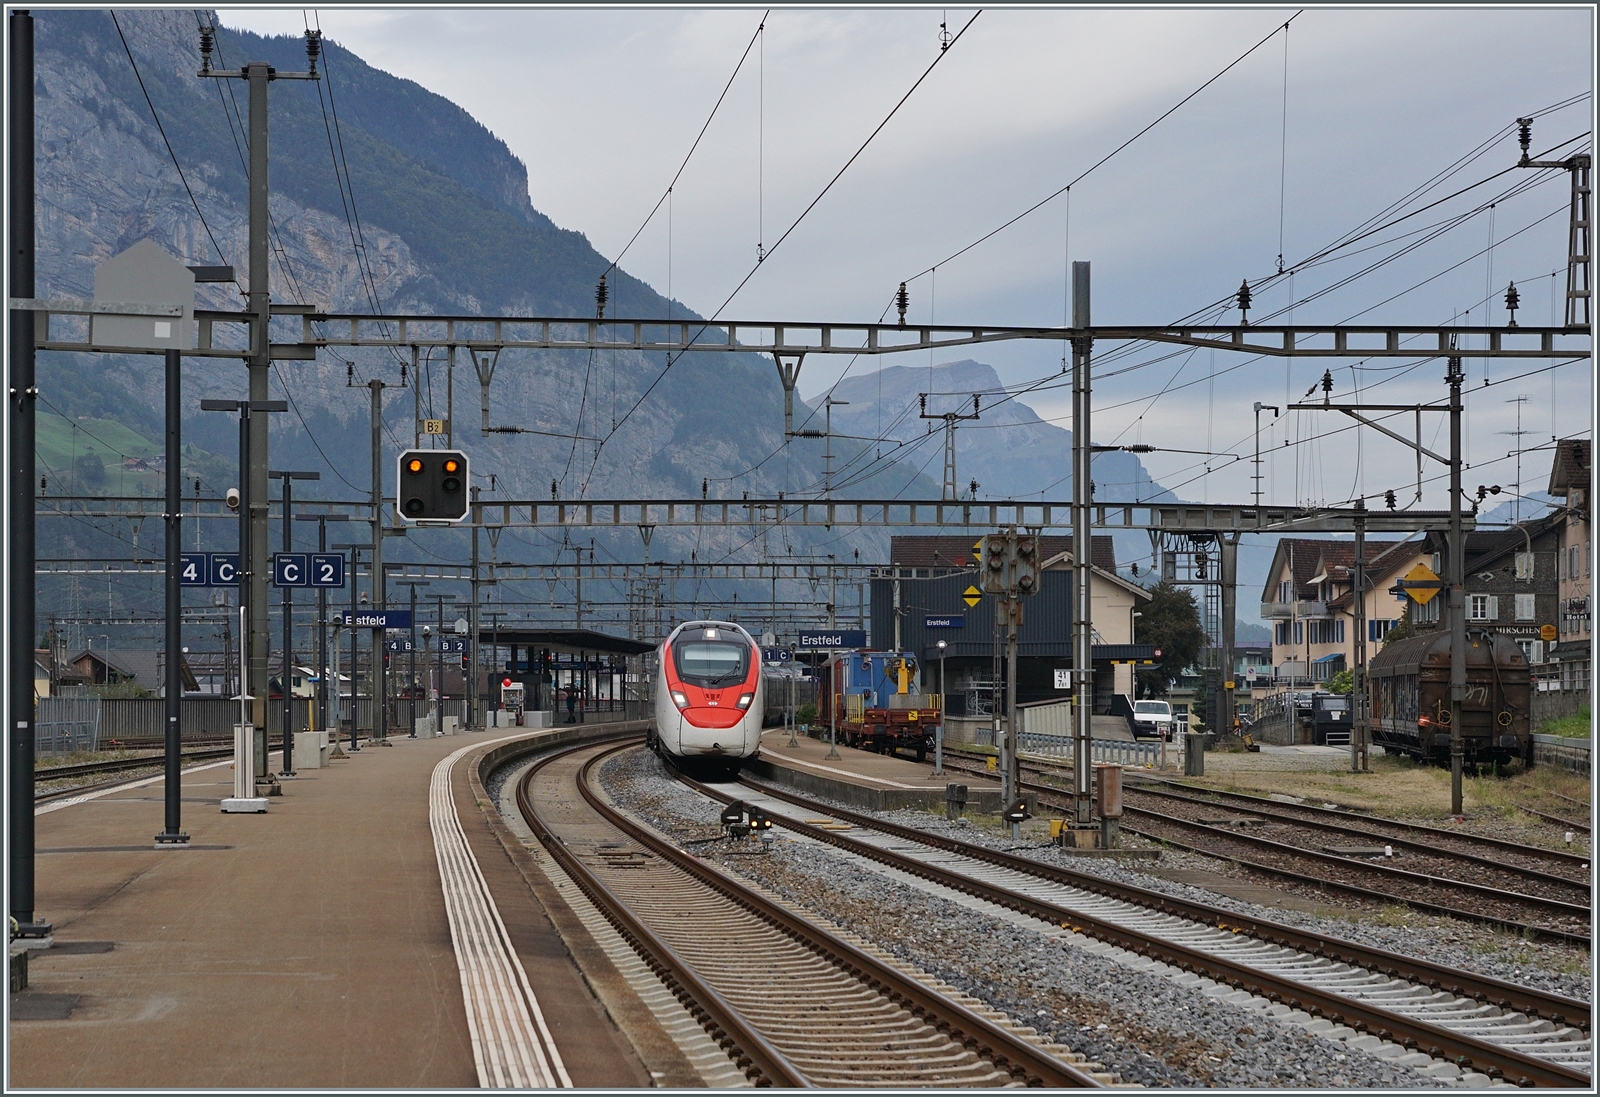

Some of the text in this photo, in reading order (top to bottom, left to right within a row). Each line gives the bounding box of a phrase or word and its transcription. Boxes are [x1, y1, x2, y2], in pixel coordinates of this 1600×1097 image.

[183, 563, 198, 580] 4
[219, 563, 234, 581] C
[284, 564, 298, 581] C
[321, 564, 334, 582] 2
[345, 616, 386, 625] Estfeld
[1496, 626, 1540, 634] HIRSCHEN
[802, 636, 841, 645] Erstfeld
[391, 642, 397, 650] 4
[405, 642, 412, 650] B
[780, 652, 787, 660] C
